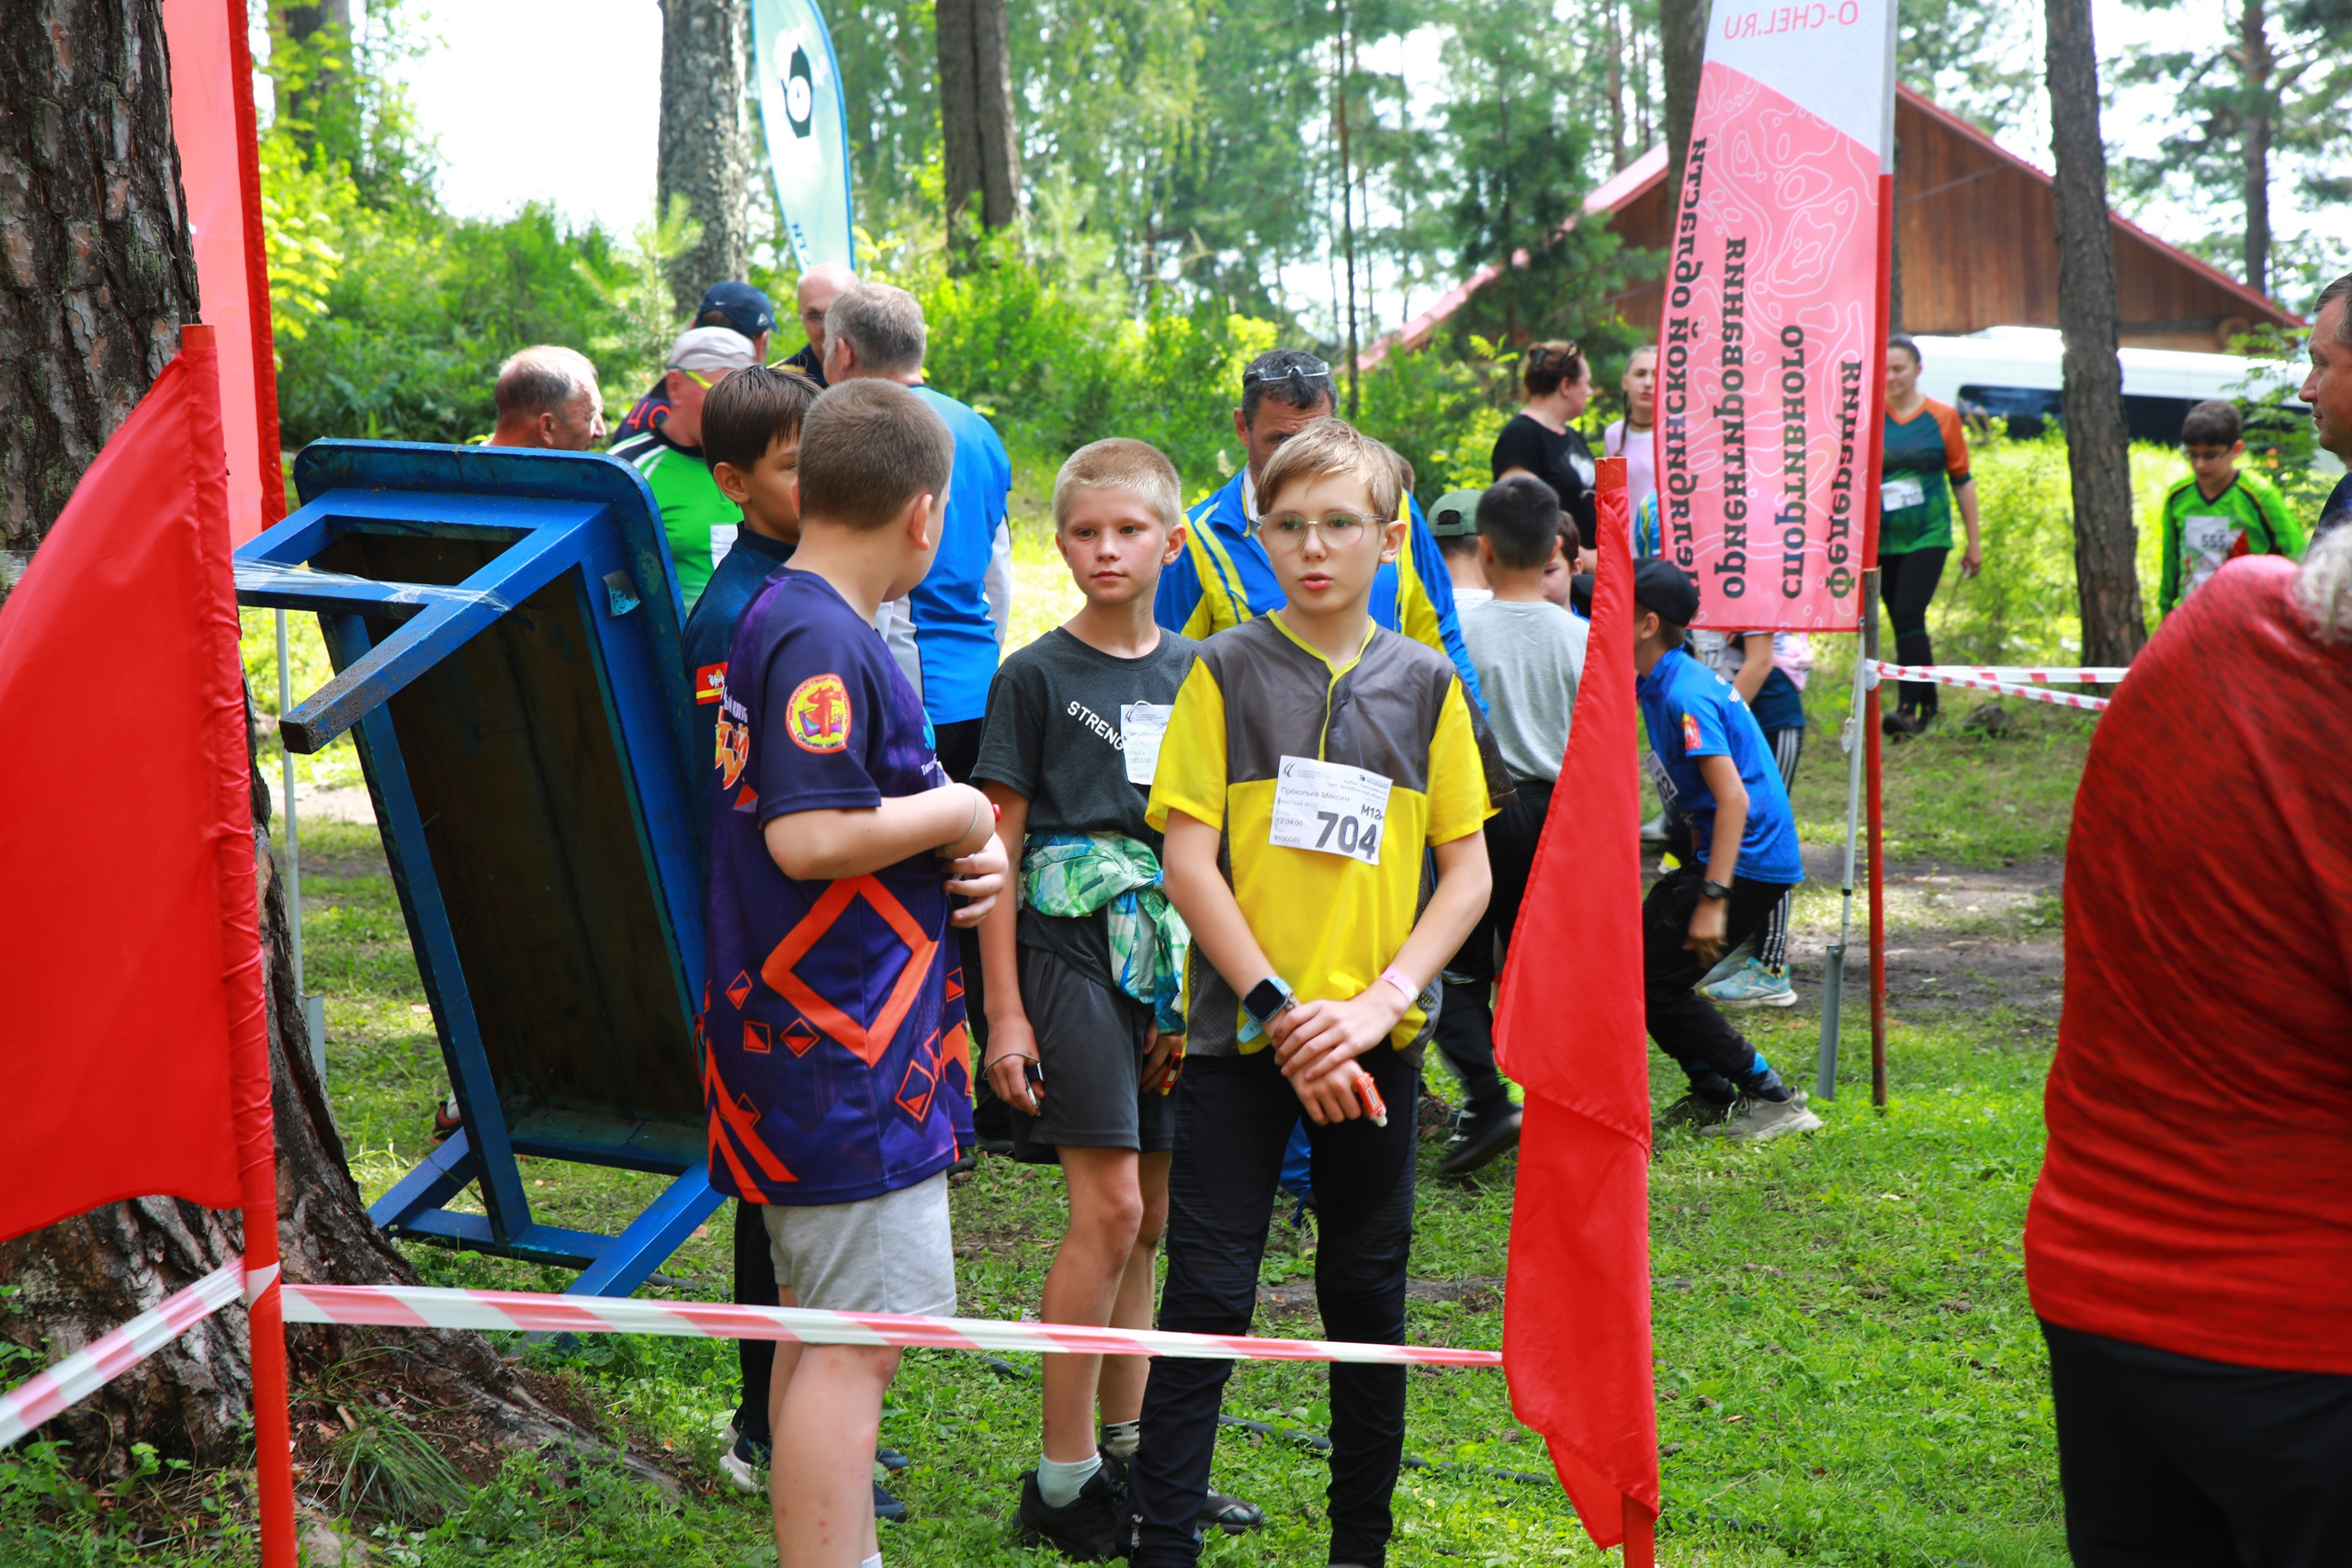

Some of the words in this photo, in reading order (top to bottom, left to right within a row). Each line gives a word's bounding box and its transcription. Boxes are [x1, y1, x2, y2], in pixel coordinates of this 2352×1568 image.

[2201, 534, 2226, 548] 555
[1280, 786, 1319, 798] Прокопьев
[1320, 792, 1351, 802] Максим
[1276, 818, 1304, 827] 12:04:00
[1315, 811, 1377, 861] 704
